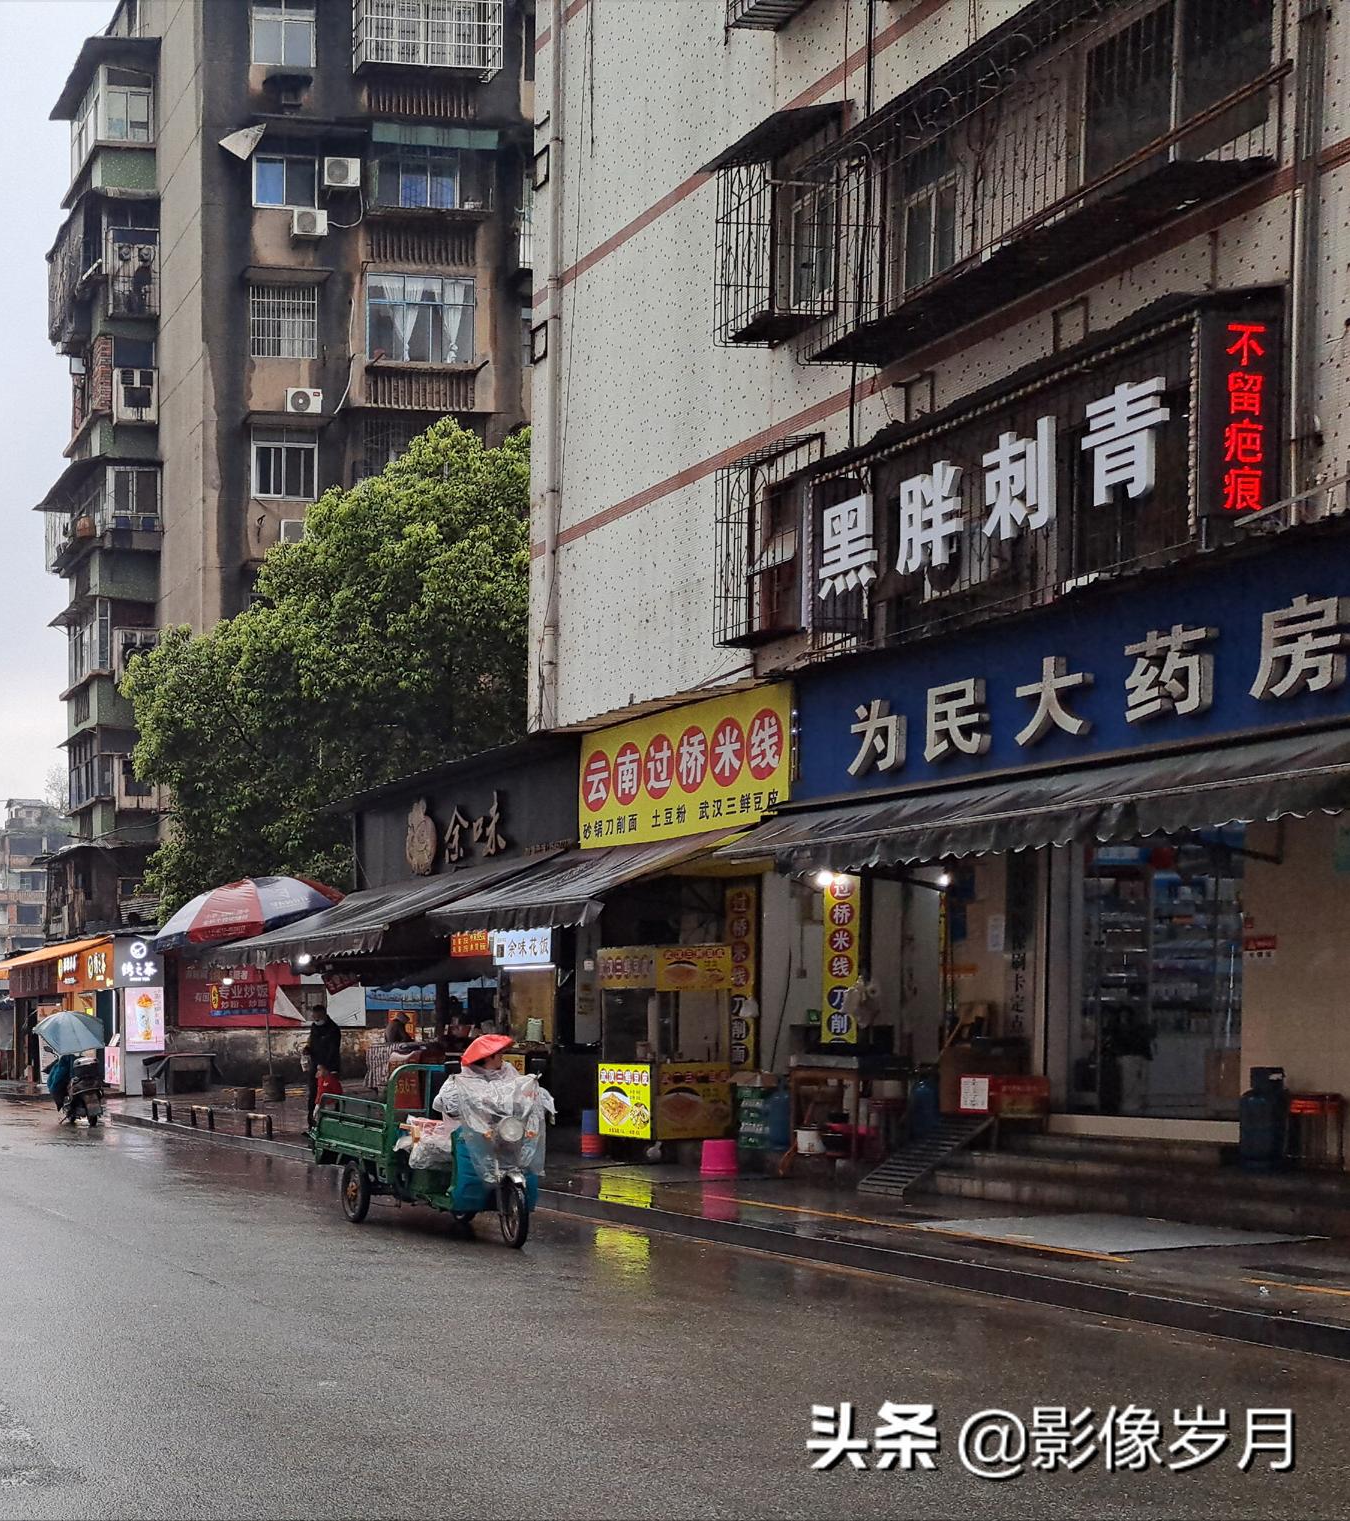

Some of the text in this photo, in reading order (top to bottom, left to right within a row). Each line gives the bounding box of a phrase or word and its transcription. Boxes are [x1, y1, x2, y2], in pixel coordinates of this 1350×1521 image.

[818, 376, 1170, 600] 黑胖刺青
[1223, 321, 1267, 511] 不留疤痕
[585, 714, 781, 808] 云南过桥米线
[846, 593, 1348, 777] 为民大药房
[582, 788, 779, 840] 砂锅刀削面 土豆粉 武汉三鲜豆皮
